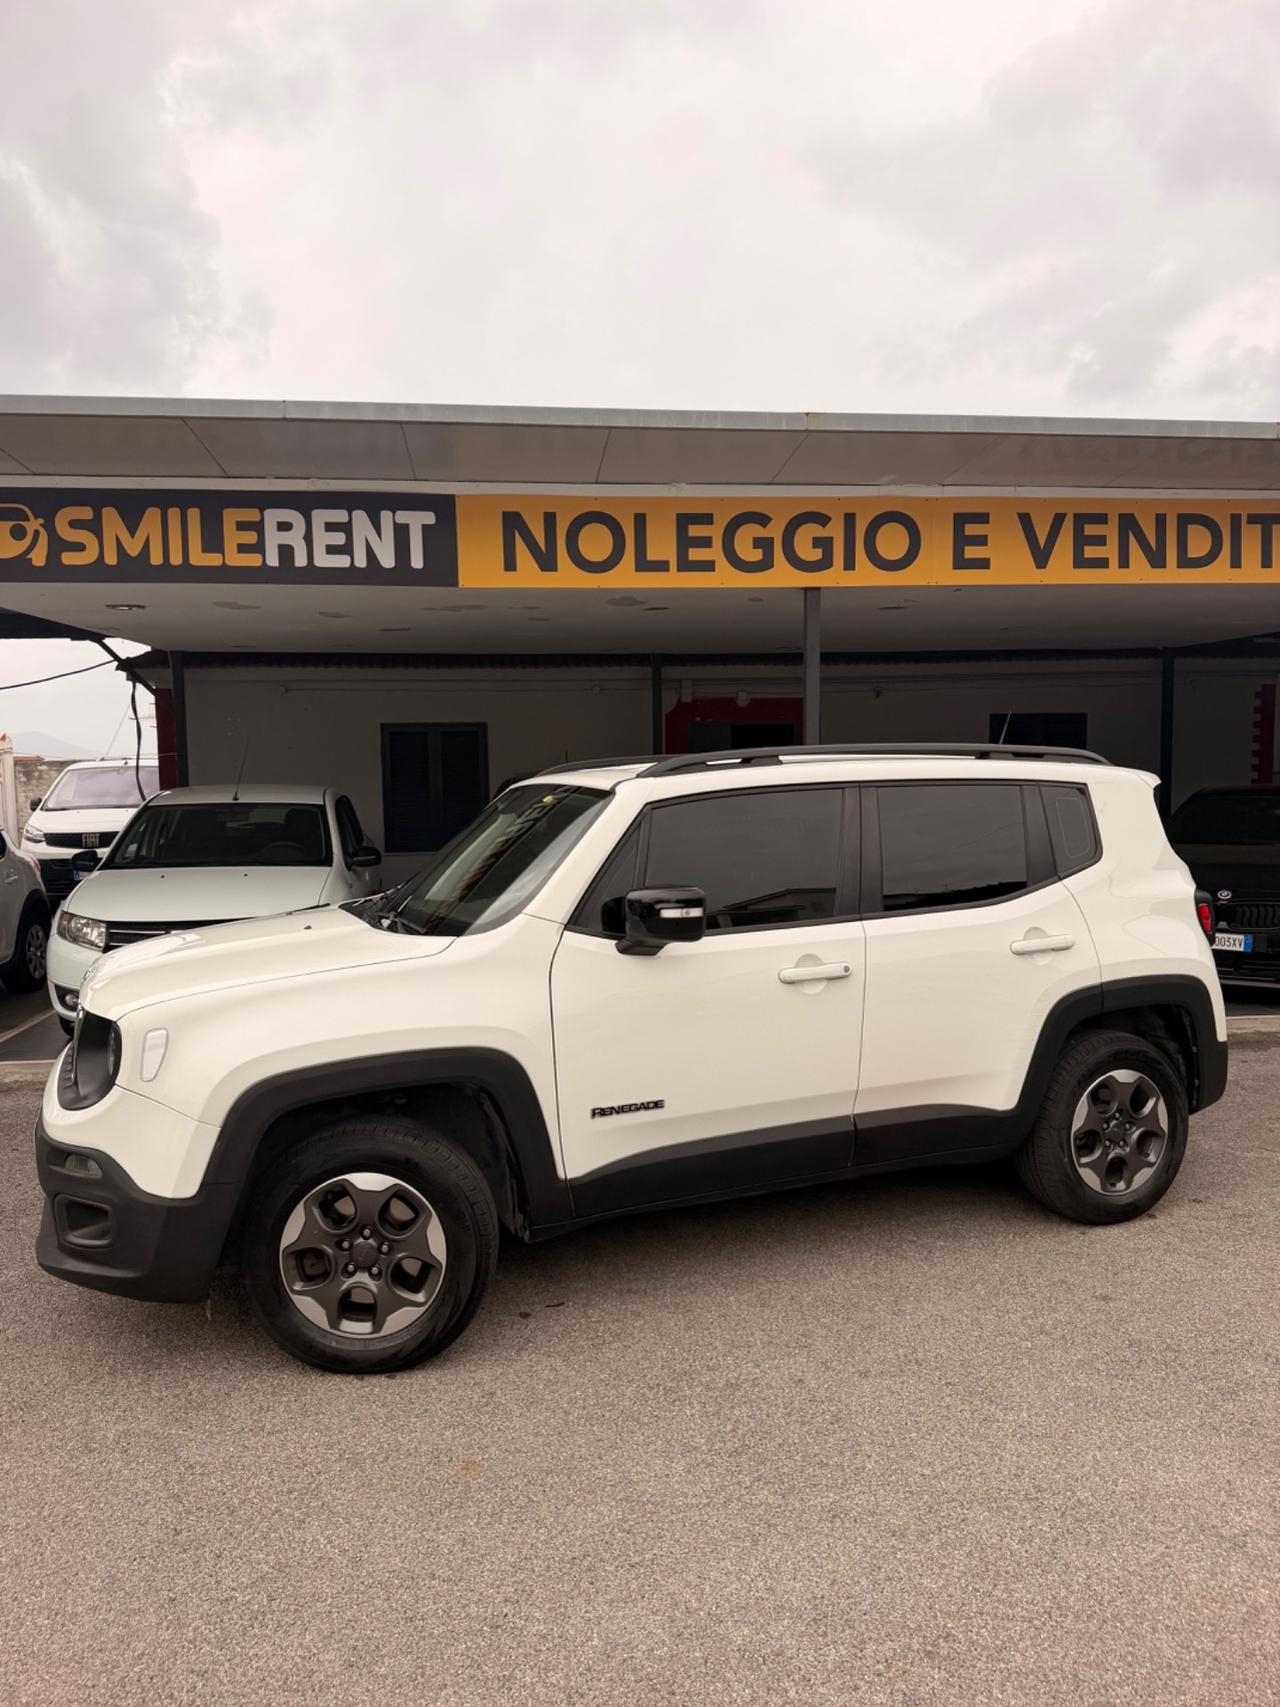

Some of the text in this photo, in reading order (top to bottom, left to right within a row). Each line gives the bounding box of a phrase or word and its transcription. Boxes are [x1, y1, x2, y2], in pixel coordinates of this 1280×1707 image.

[54, 506, 436, 569] SMILERENT
[502, 510, 1280, 574] NOLEGGIO E VENDIT
[81, 832, 100, 848] FIAT
[591, 1099, 665, 1119] RENEGADE
